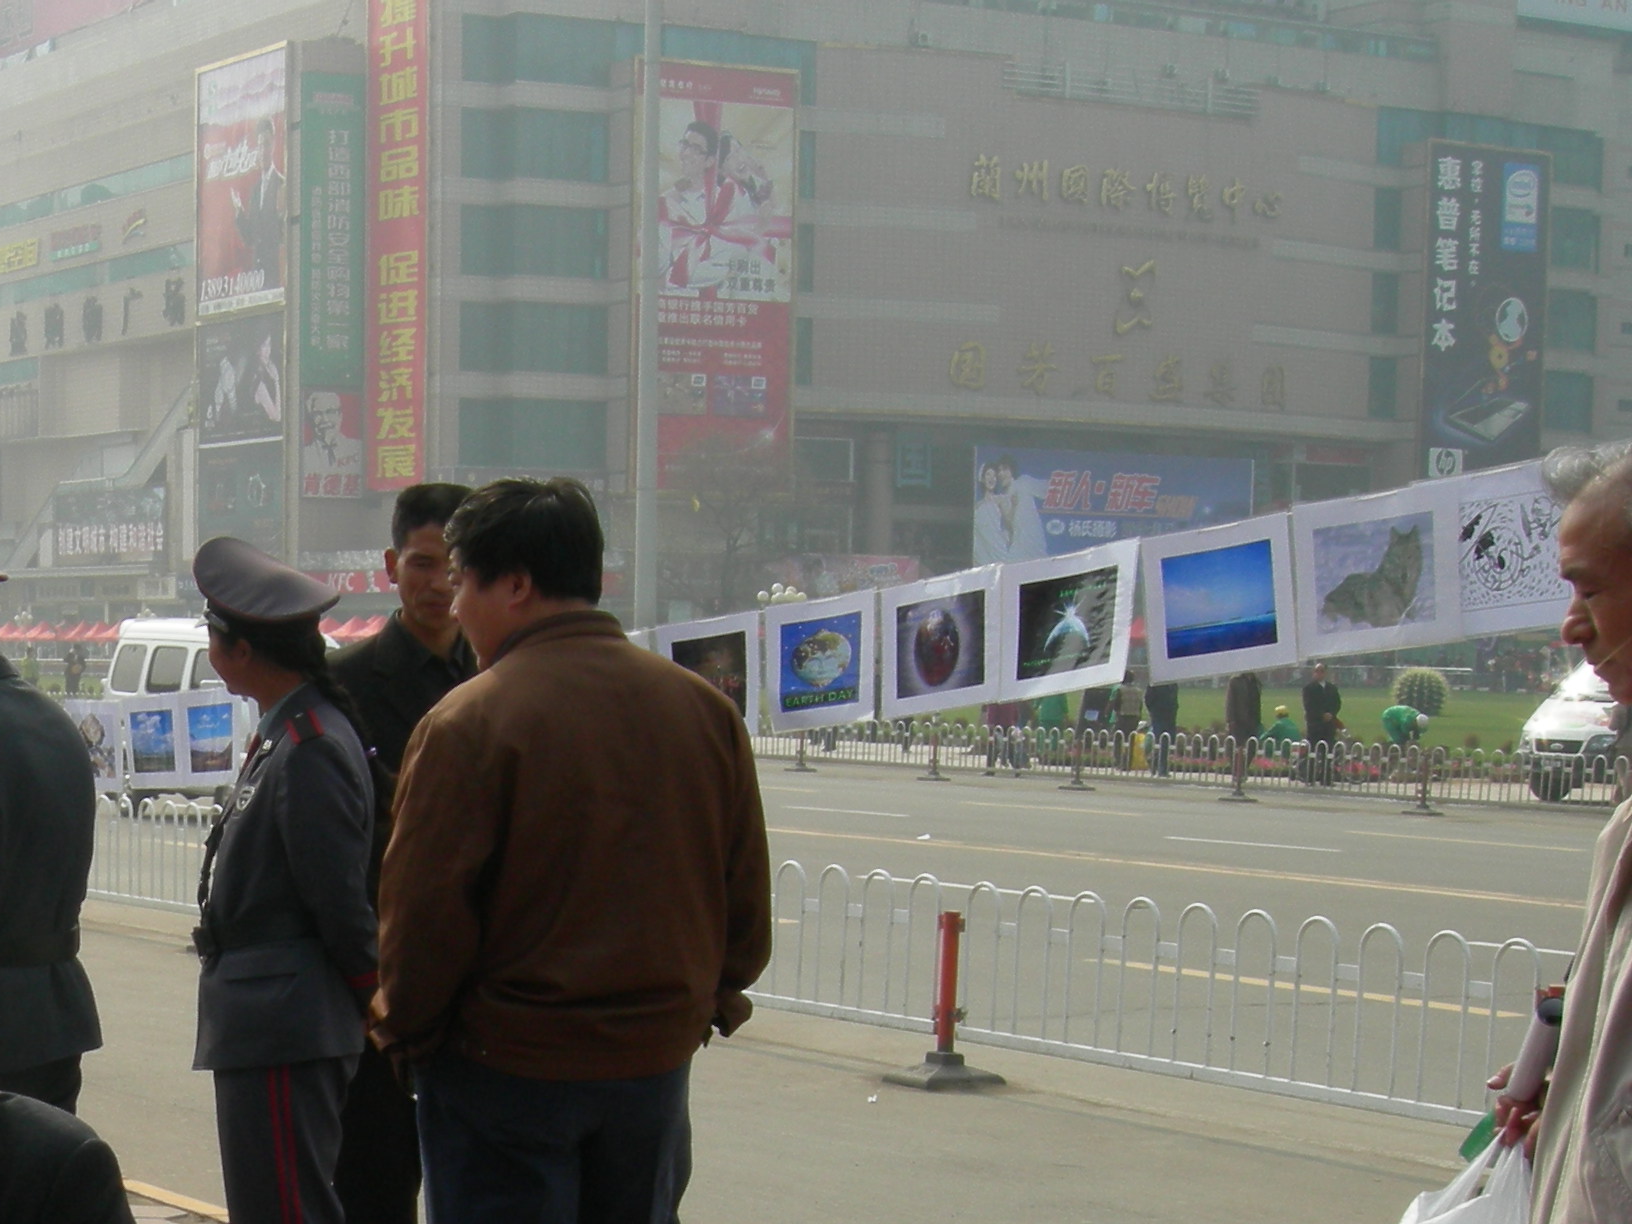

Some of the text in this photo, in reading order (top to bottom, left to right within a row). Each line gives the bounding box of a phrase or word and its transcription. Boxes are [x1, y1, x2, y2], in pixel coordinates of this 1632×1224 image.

[376, 0, 420, 222] 提升城市品味
[1430, 156, 1462, 353] 惠普笔记本
[375, 249, 420, 480] 促进经济发展
[304, 473, 362, 498] 肯德基
[1042, 469, 1162, 513] 新人·新车
[326, 571, 355, 591] KFC
[784, 690, 854, 708] EARTH DAY
